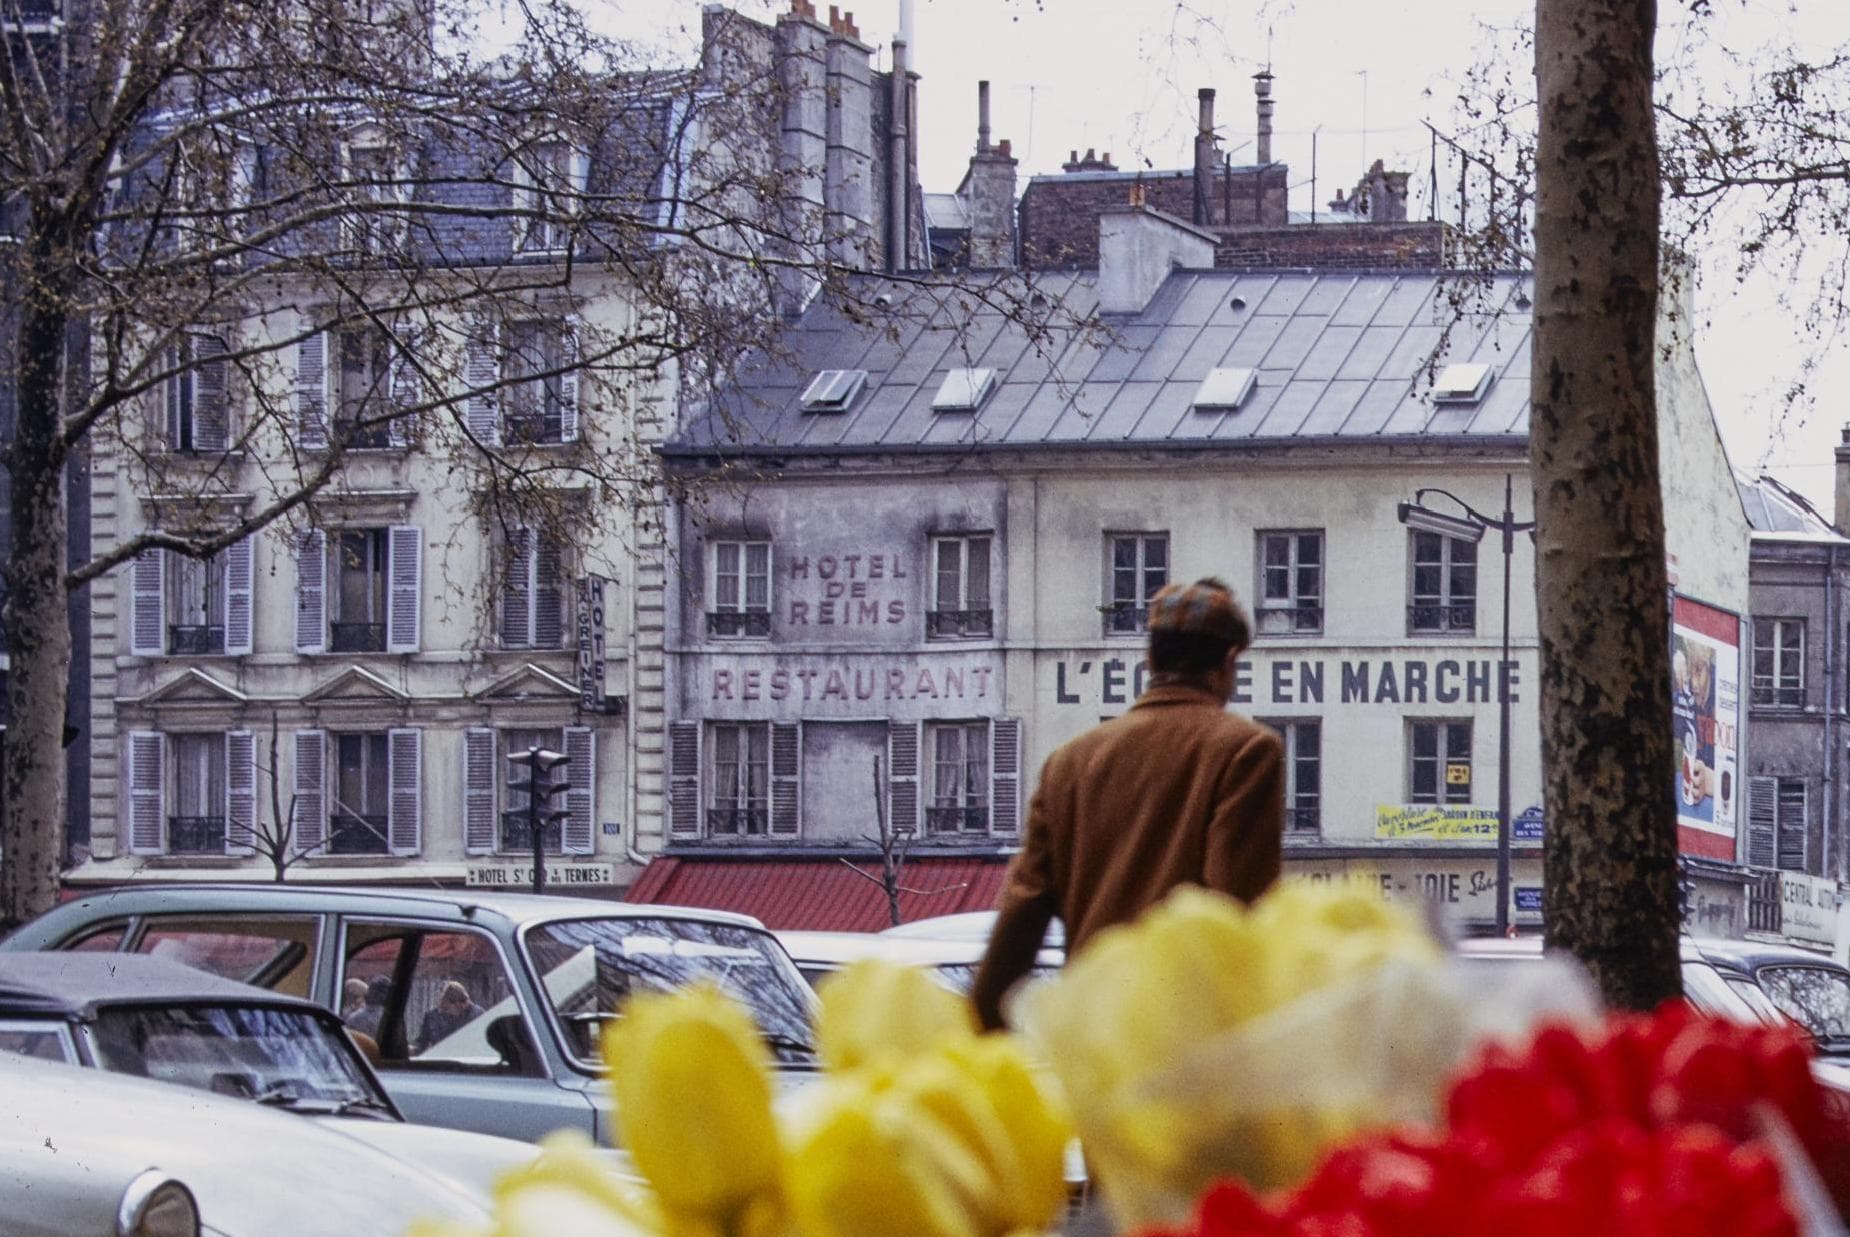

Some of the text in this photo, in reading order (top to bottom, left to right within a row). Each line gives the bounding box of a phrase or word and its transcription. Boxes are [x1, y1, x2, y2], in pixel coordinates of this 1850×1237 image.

[790, 554, 907, 581] HOTEL
[826, 582, 866, 598] DE
[789, 601, 906, 625] REIMS
[591, 580, 605, 707] HOTEL
[712, 667, 993, 702] RESTAURANT
[1057, 658, 1520, 704] L'ÉE EN MARCHE
[478, 868, 508, 883] HOTEL
[564, 868, 601, 883] TERNES
